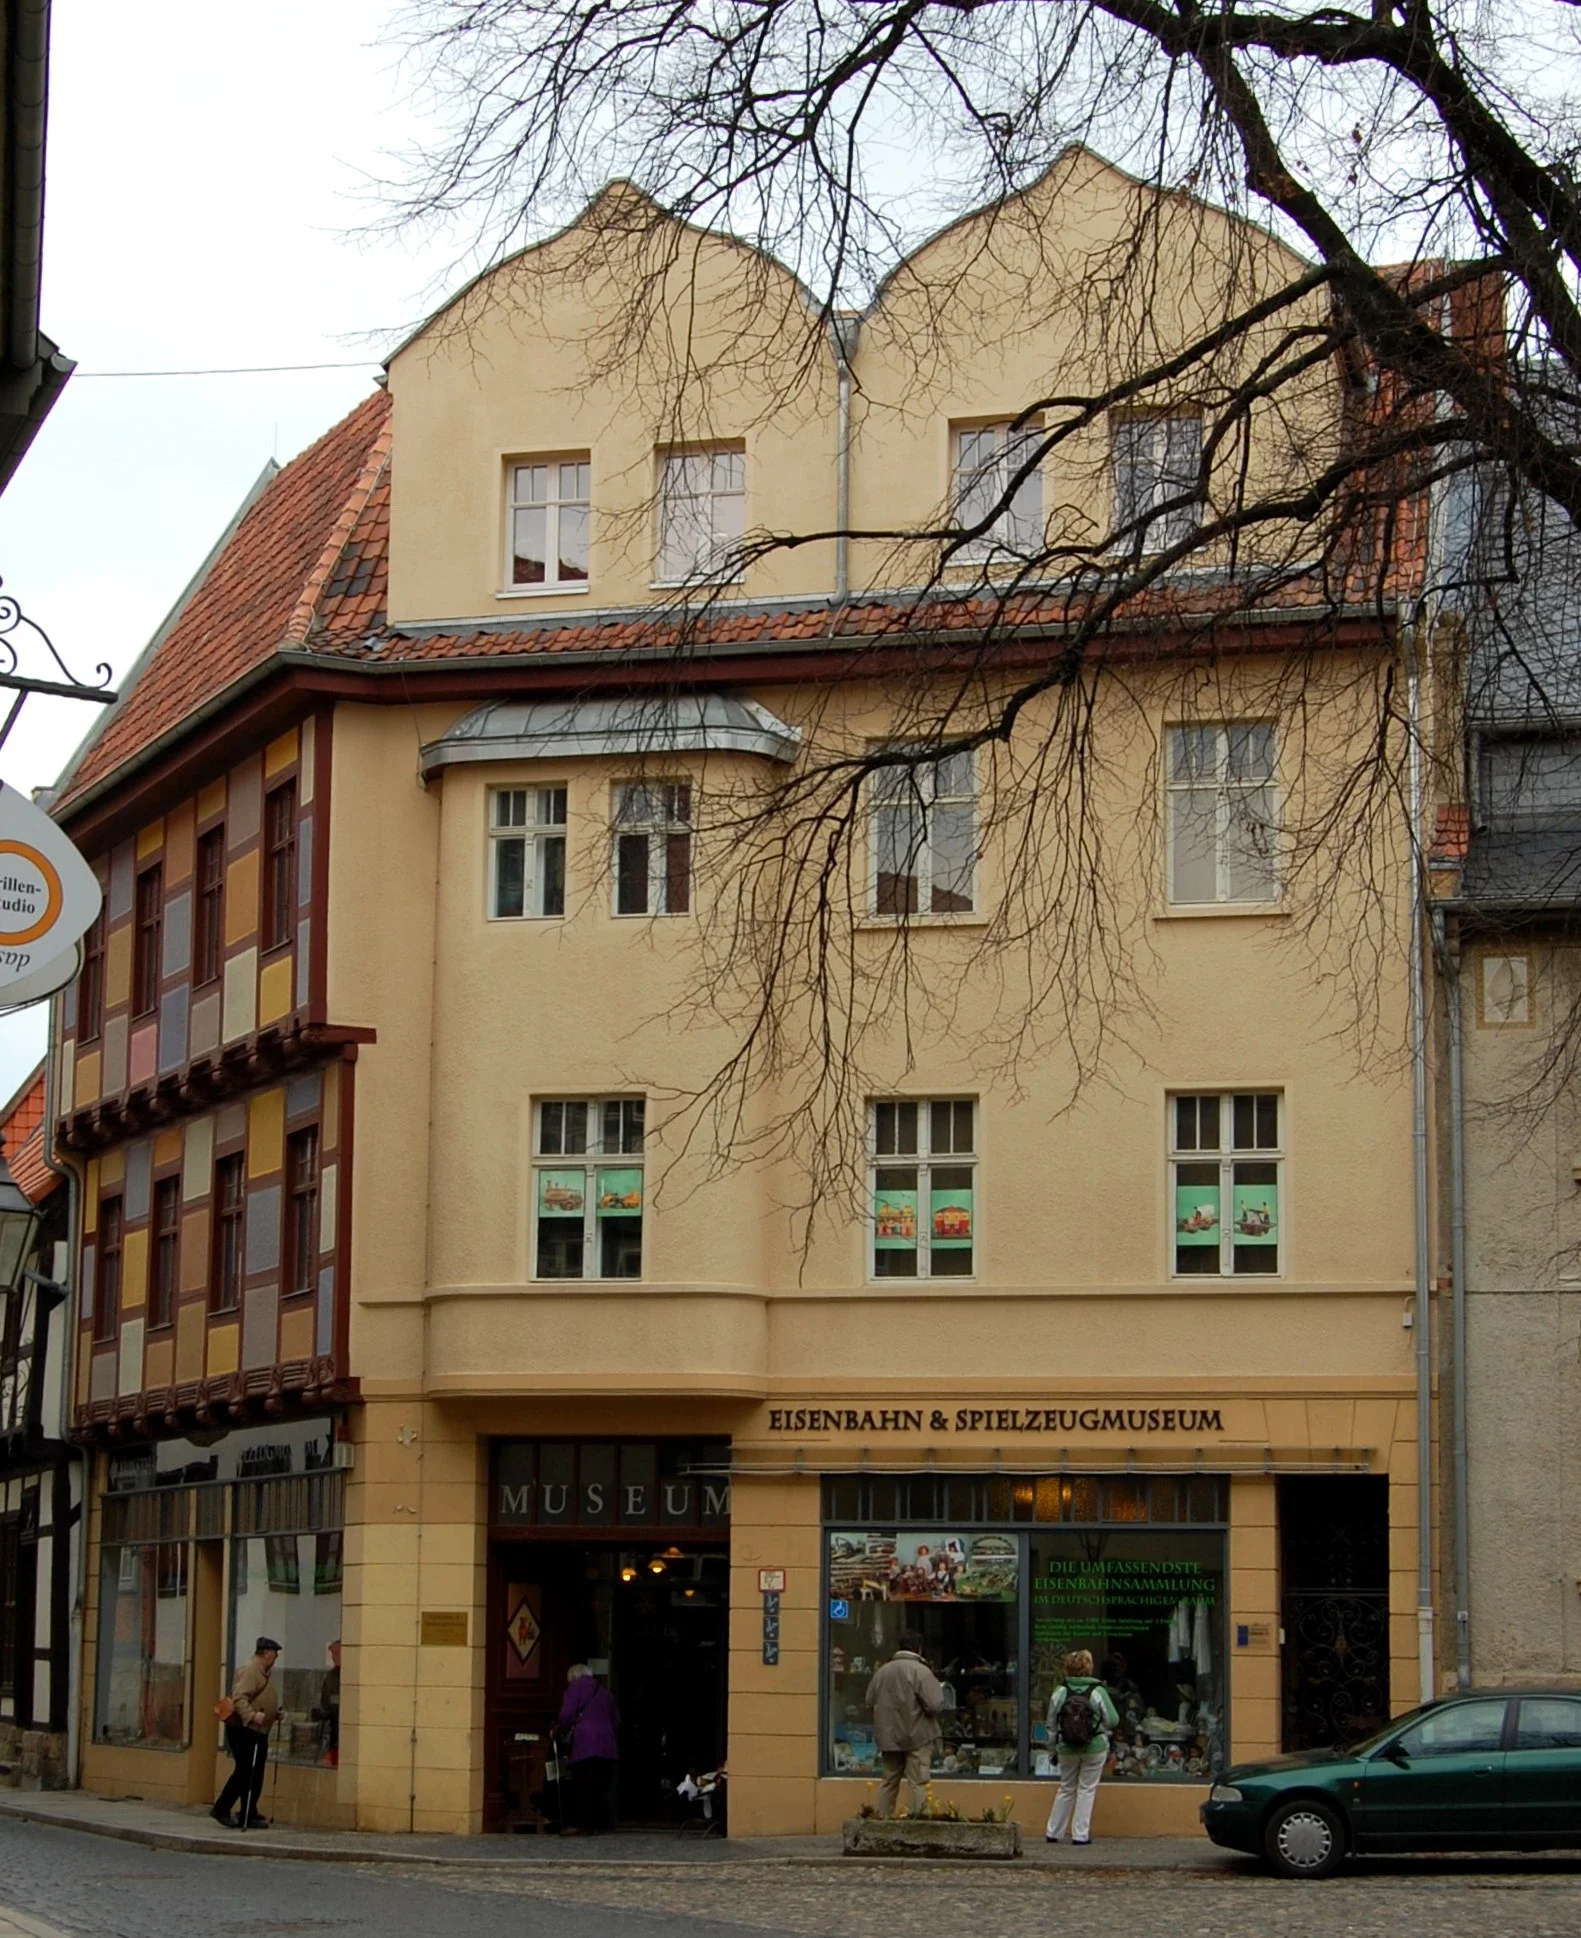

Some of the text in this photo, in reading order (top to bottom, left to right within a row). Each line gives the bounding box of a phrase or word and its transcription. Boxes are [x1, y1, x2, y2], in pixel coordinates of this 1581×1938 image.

[0, 876, 42, 895] illen-
[0, 898, 35, 914] udio
[768, 1408, 1224, 1432] EISENBAHN & SPIELZEUGMUSEUM
[501, 1483, 730, 1515] MUSEUM
[1050, 1561, 1202, 1575] DIE UMFASSENDSTE
[1034, 1577, 1216, 1592] EISENBAHNSAMMLUNG
